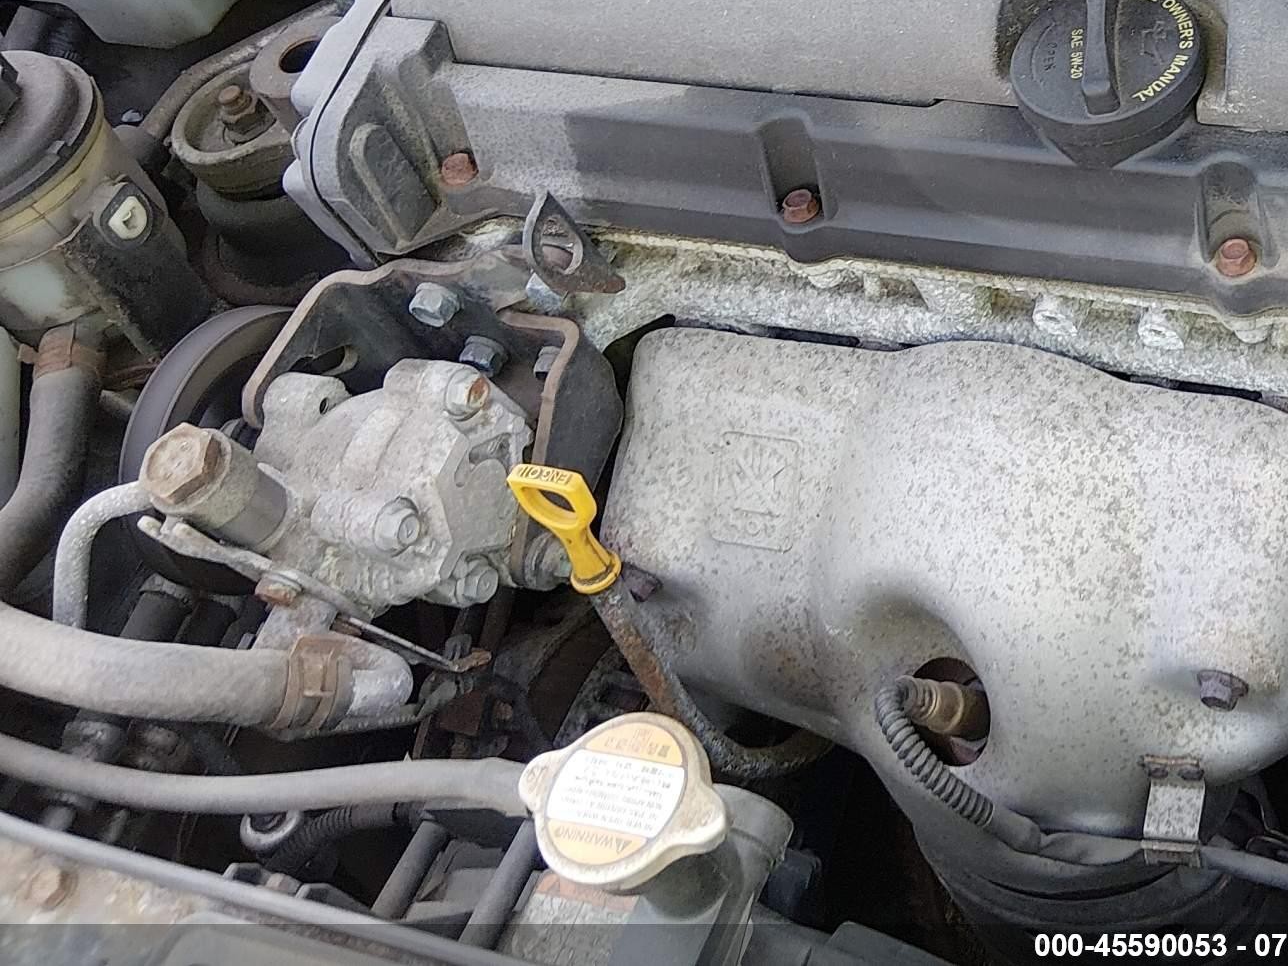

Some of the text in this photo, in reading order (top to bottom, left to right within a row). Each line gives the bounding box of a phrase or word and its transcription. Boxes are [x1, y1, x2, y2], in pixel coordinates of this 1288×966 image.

[1070, 28, 1084, 80] SAE 5W-20
[1131, 54, 1189, 102] MANUAL
[554, 825, 613, 850] WARNING
